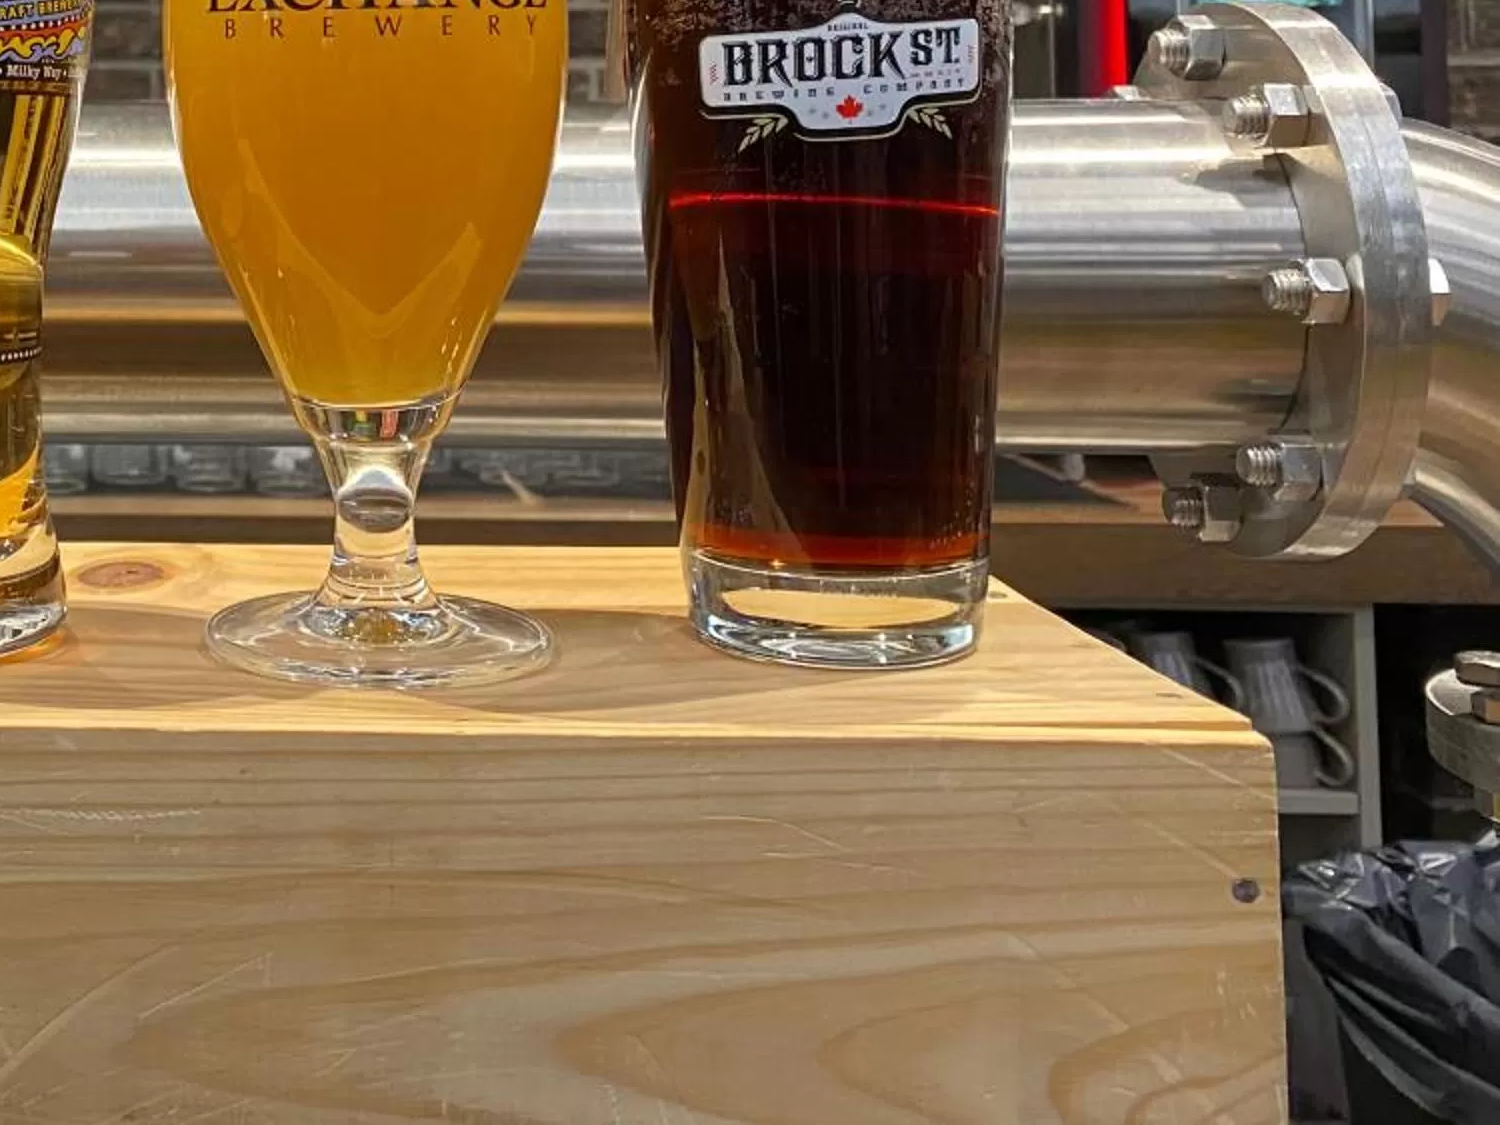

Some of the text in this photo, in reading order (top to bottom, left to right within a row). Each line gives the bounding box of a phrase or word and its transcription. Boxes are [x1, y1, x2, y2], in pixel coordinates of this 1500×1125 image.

[225, 14, 538, 40] BREWERY
[6, 63, 41, 81] Milky
[722, 30, 906, 88] BROCK
